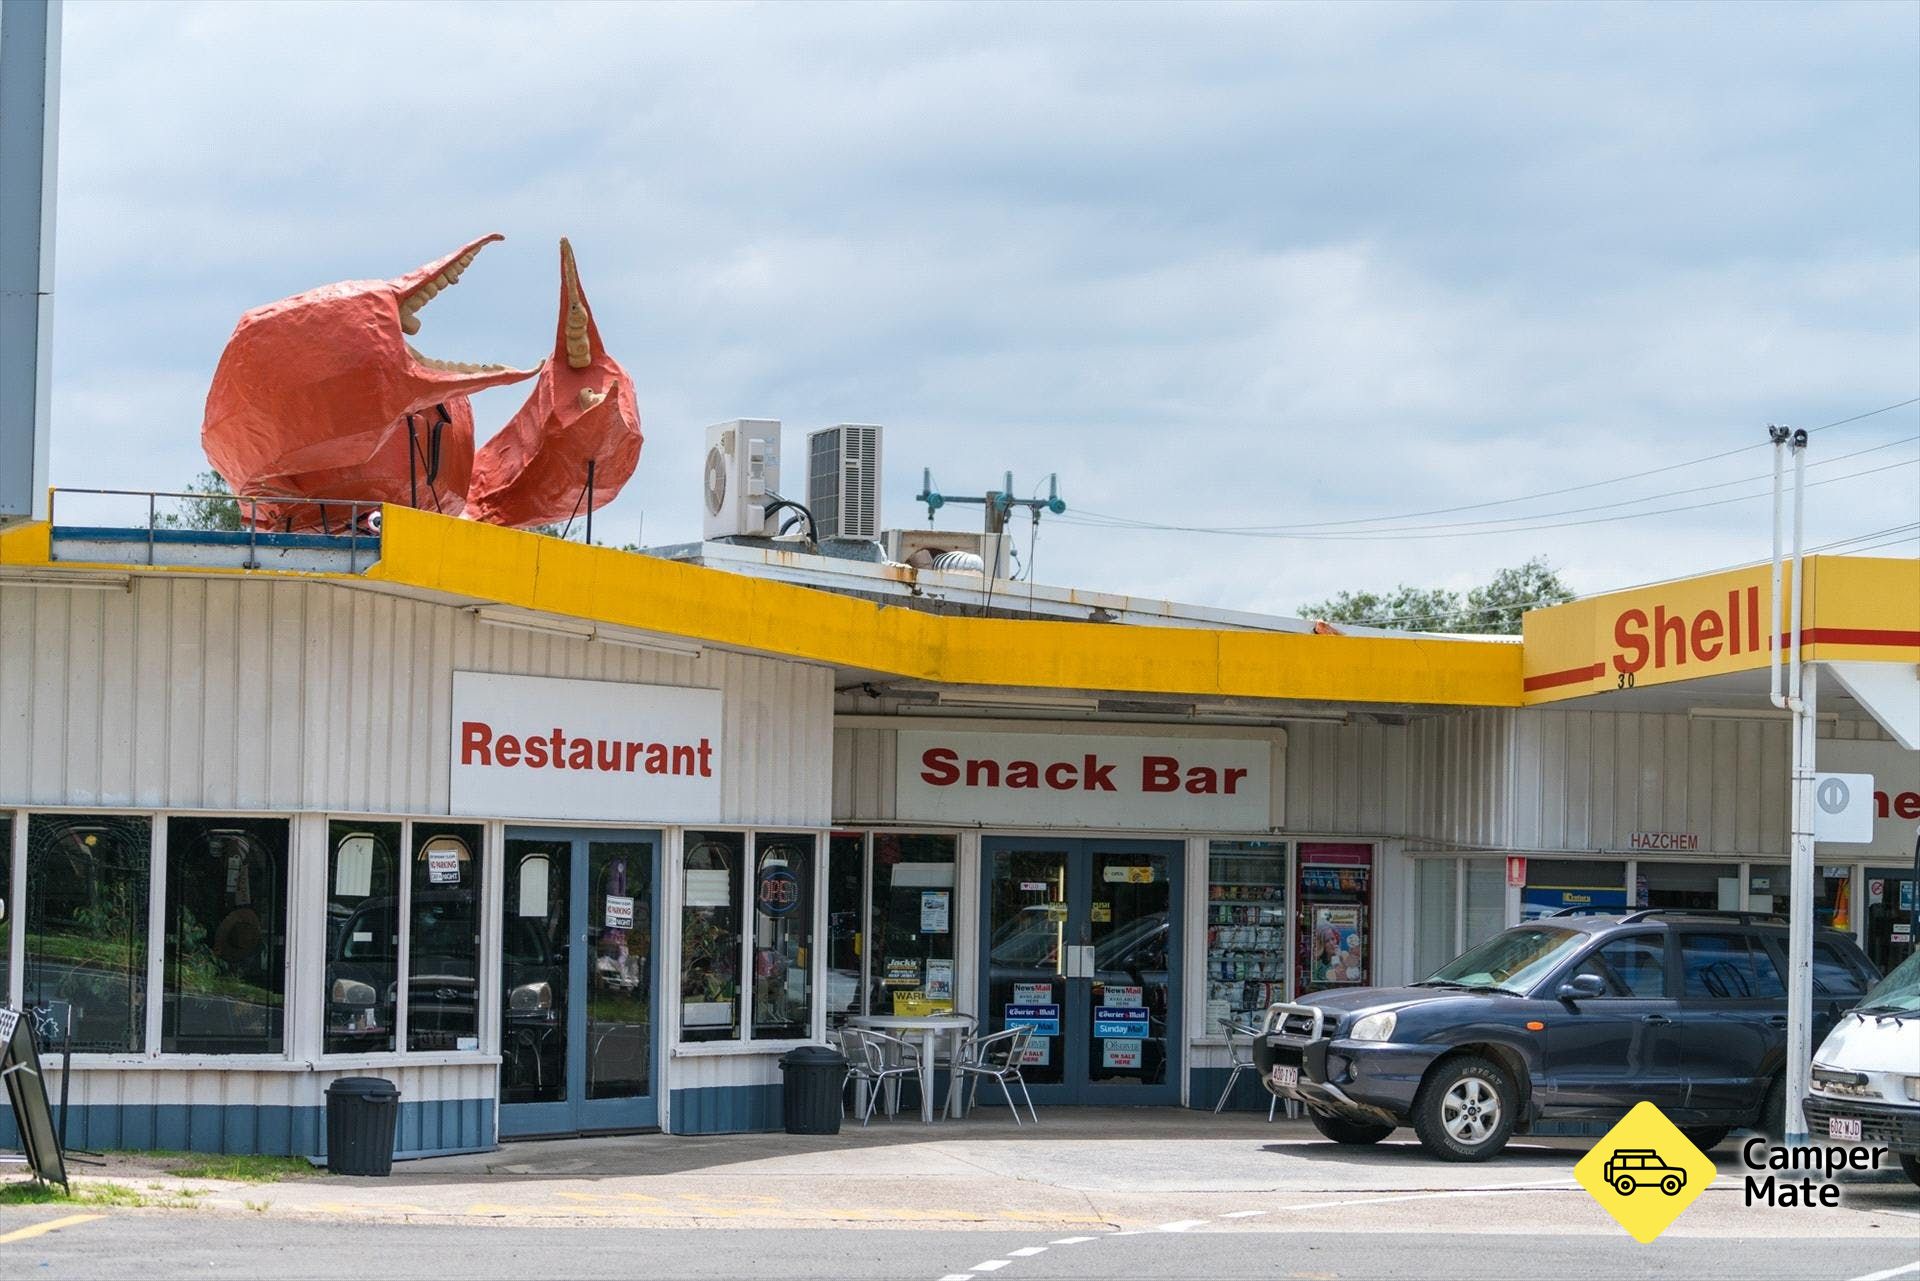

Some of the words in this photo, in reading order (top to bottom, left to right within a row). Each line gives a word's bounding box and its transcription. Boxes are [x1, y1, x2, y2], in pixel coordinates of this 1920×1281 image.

[1612, 585, 1760, 675] Shell
[461, 721, 713, 778] Restaurant
[920, 747, 1118, 792] Snack
[1141, 755, 1248, 794] Bar
[1631, 833, 1699, 850] HAZCHEM
[760, 880, 798, 903] OPEN
[1015, 984, 1051, 992] NewsMail
[1105, 986, 1141, 994] NewsMail
